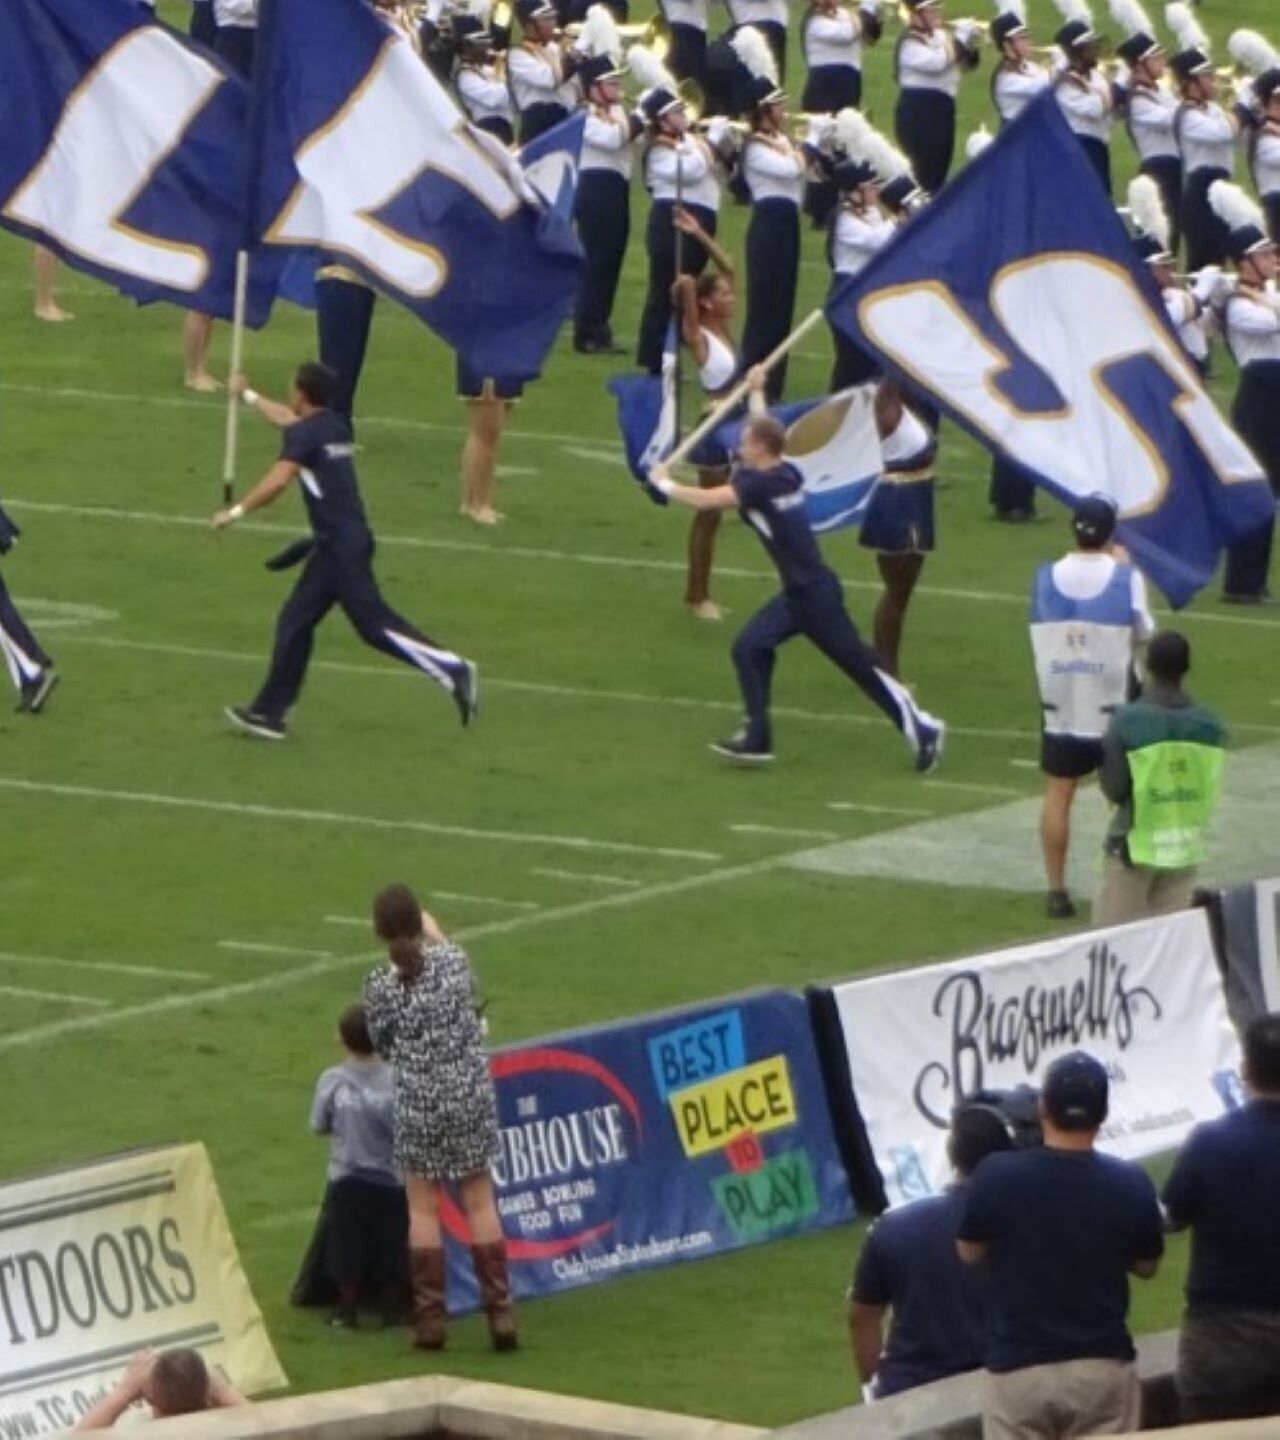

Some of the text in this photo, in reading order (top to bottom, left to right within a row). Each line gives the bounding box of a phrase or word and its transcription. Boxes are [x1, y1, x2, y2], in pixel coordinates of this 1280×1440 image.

[0, 23, 227, 294] L
[857, 250, 1268, 521] S
[657, 1023, 731, 1086] BEST
[491, 1104, 628, 1187] UBHOUSE
[681, 1071, 789, 1146] PLACE
[724, 1164, 806, 1226] PLAY
